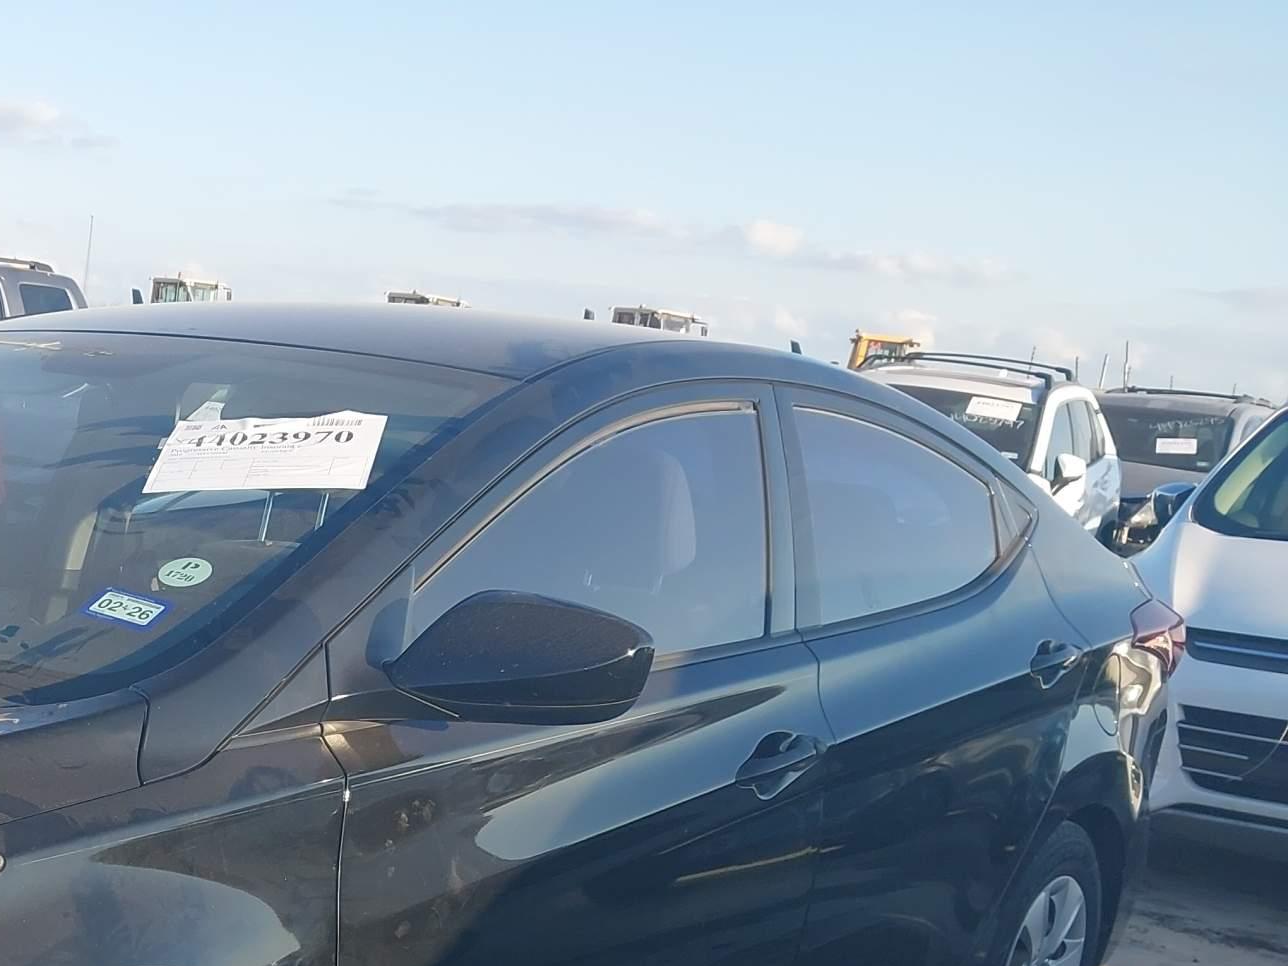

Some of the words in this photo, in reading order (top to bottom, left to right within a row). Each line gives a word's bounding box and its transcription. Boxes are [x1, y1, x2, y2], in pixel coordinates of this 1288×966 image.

[186, 430, 354, 448] 44023970
[97, 598, 123, 612] 02
[126, 606, 154, 620] 26
